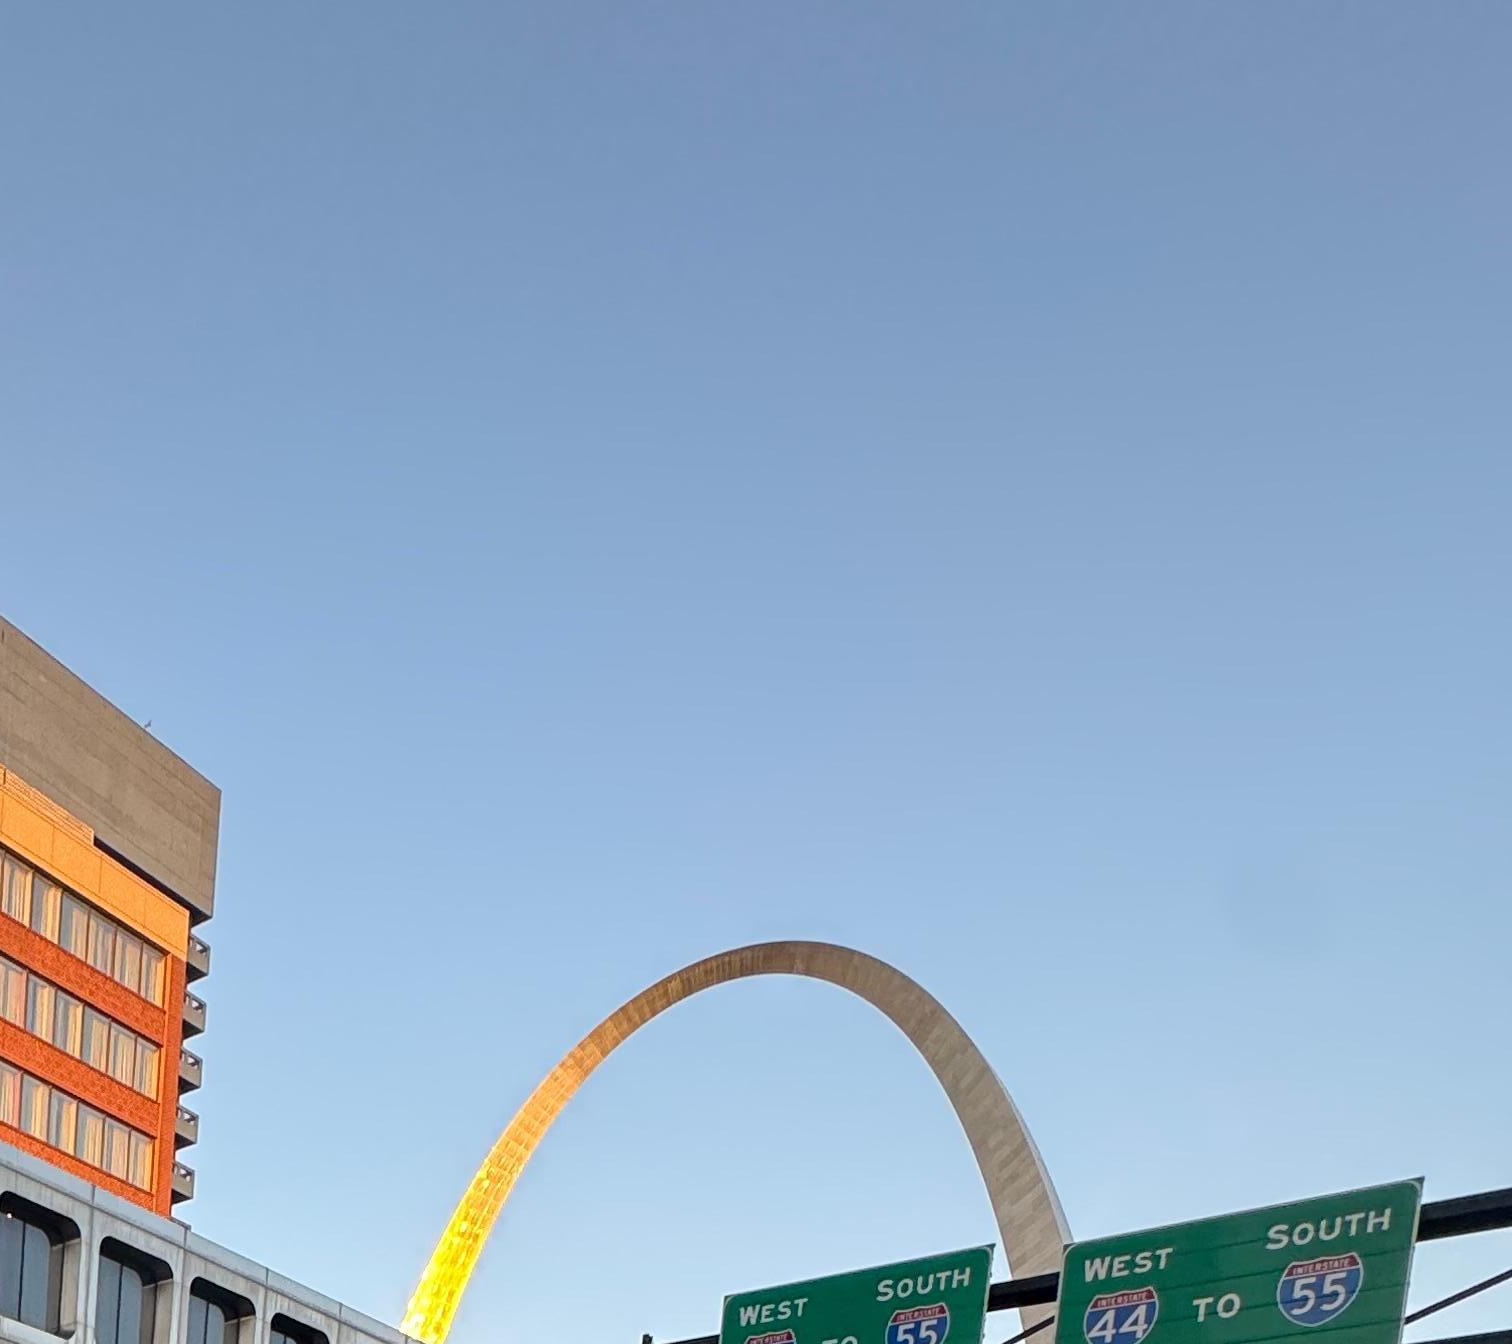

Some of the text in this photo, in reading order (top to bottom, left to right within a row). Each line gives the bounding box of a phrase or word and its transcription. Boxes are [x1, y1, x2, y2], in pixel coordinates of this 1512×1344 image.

[1084, 1207, 1392, 1282] WEST SOUTH
[1292, 1257, 1351, 1277] INTERSTATE
[739, 1266, 971, 1327] WEST SOUTH
[896, 1307, 941, 1322] INTERSTATE
[1087, 1271, 1348, 1344] 44 TO 55
[1096, 1291, 1148, 1308] INTERSTATE
